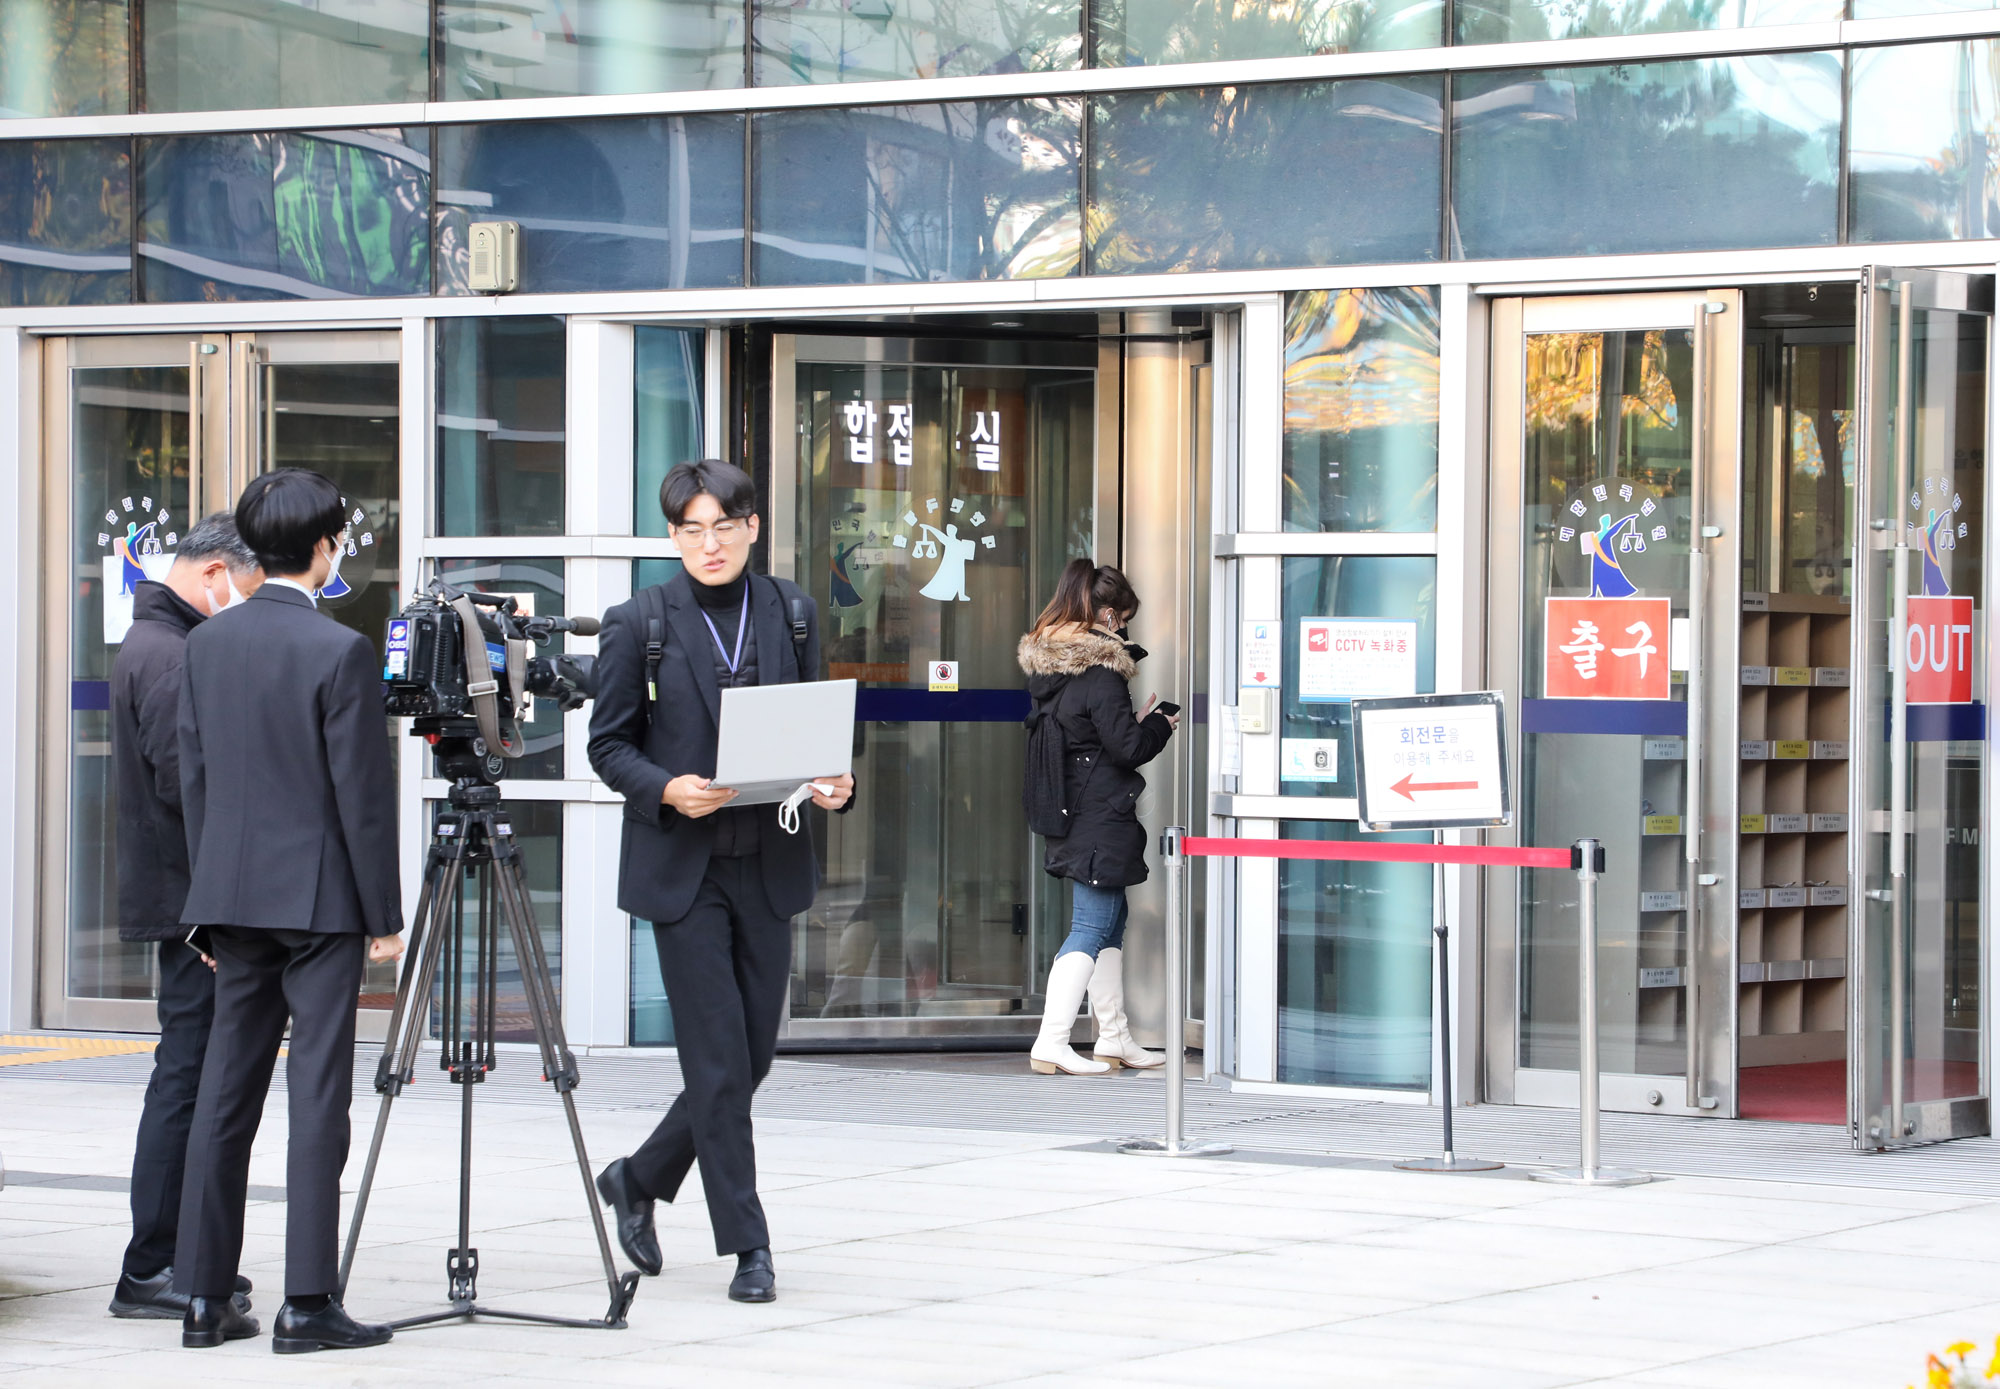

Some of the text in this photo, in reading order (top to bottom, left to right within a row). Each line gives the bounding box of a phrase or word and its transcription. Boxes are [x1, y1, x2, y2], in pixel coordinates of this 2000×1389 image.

[801, 400, 999, 471] 합접실
[388, 640, 407, 649] OBS
[1336, 639, 1408, 653] CCTV 녹화중
[1559, 620, 1657, 679] 출구
[1906, 623, 1970, 672] OUT
[1400, 725, 1460, 745] 회전문을
[1393, 749, 1476, 768] 이용해 주세요
